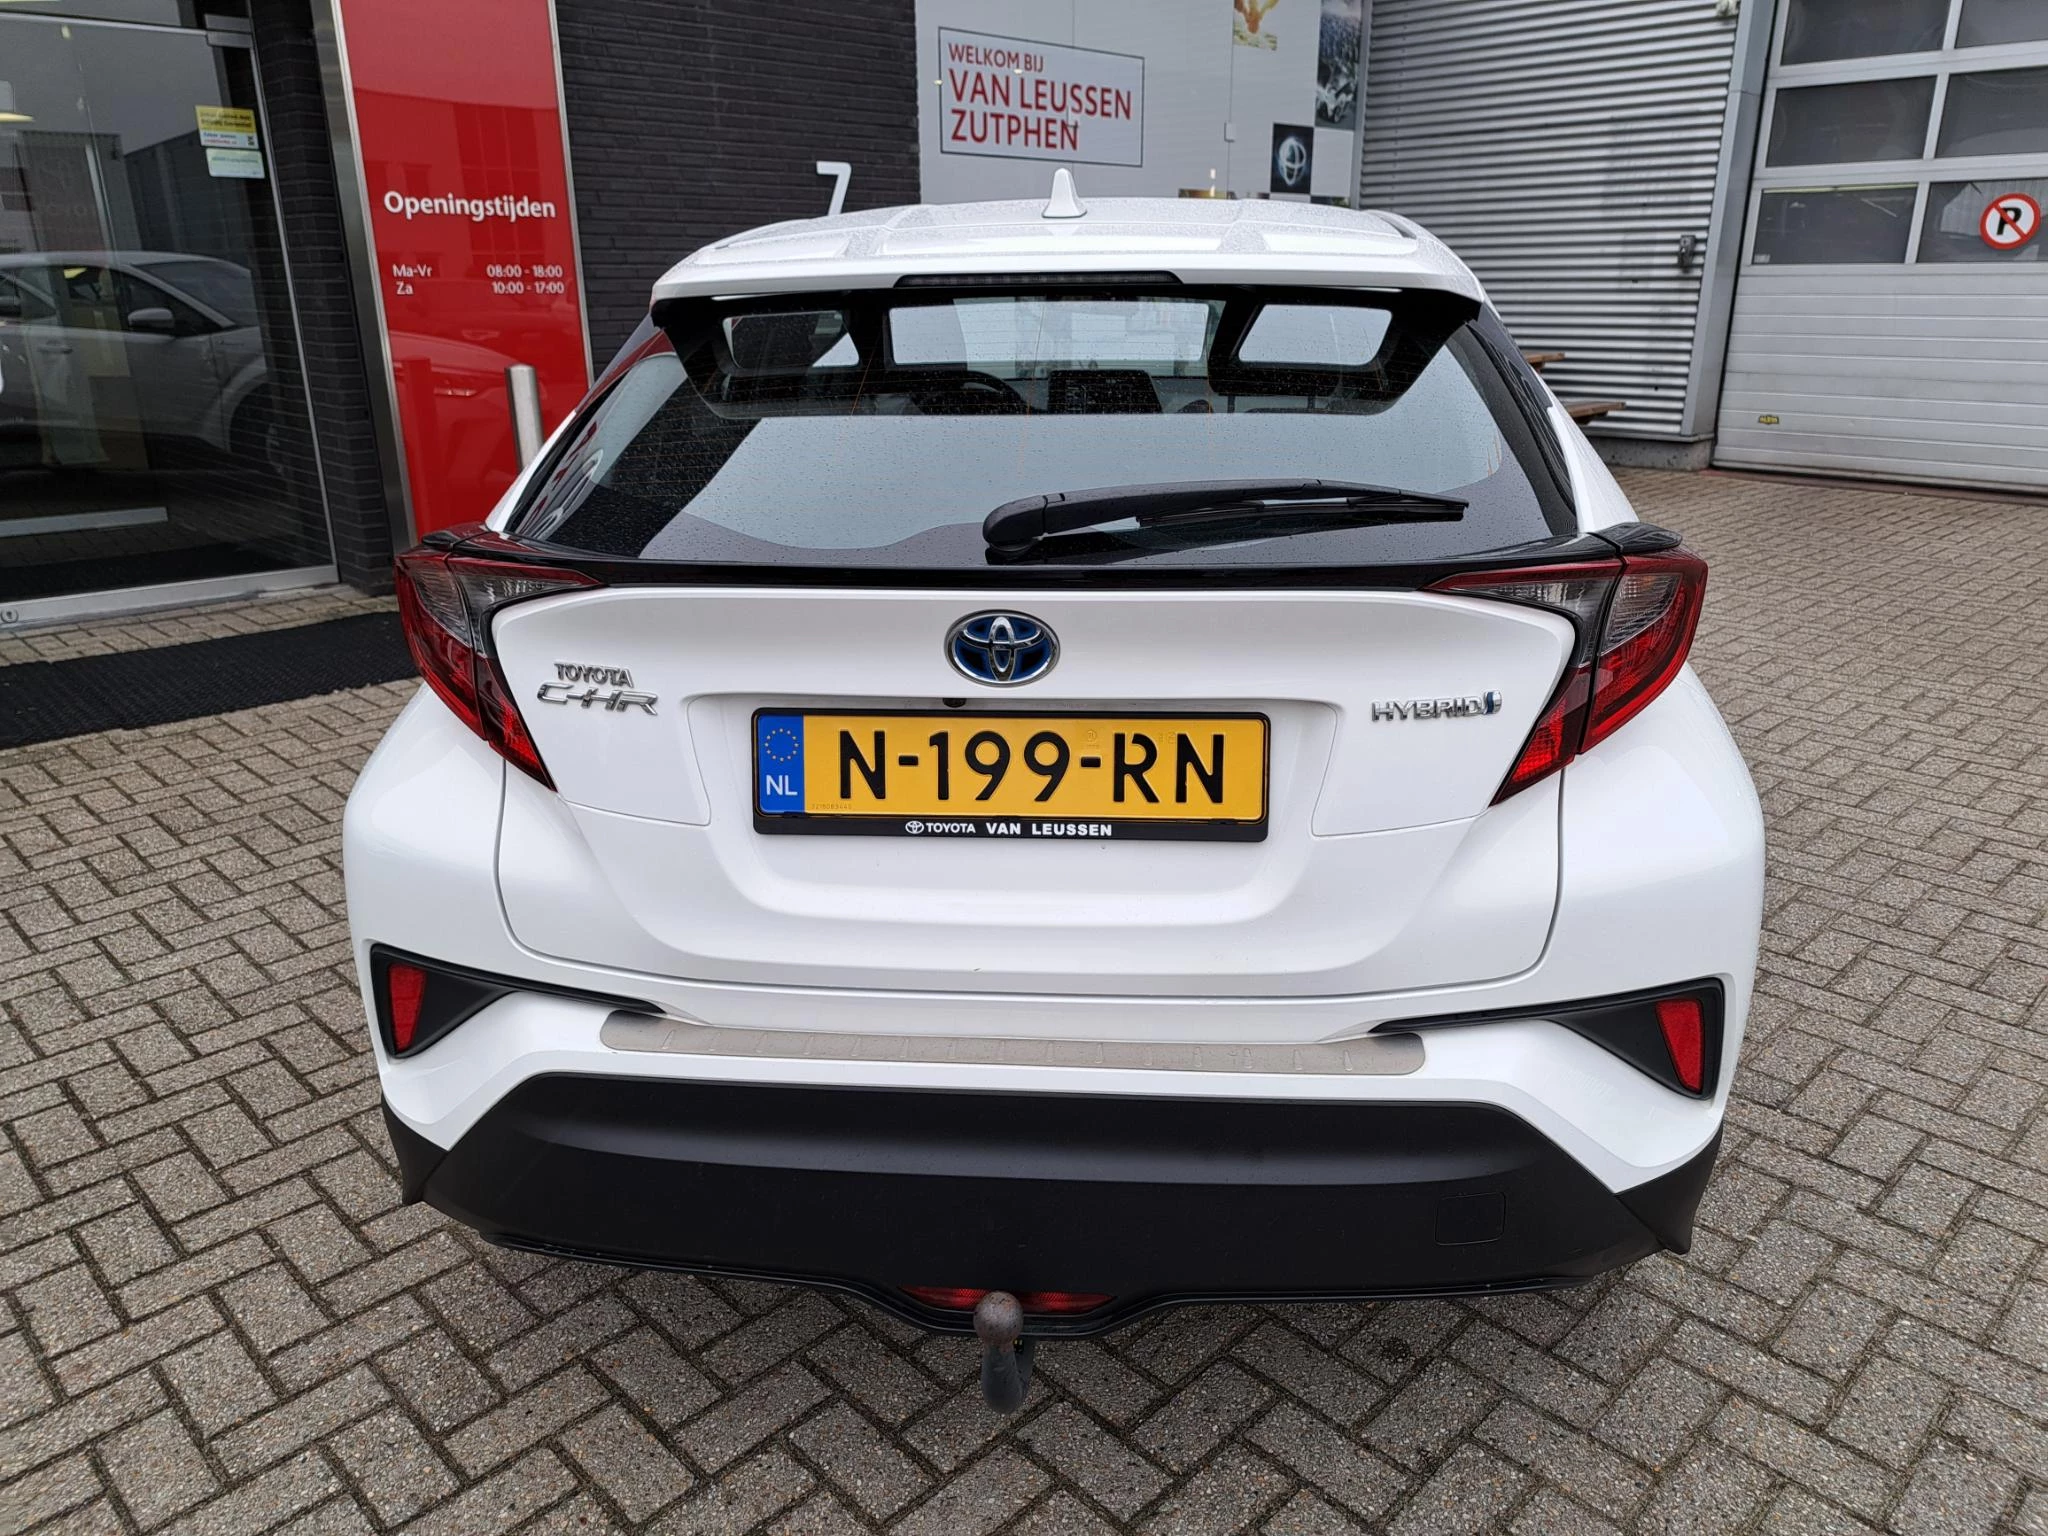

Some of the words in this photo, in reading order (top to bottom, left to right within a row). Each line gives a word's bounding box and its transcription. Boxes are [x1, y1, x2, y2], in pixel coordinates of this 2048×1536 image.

[948, 43, 1020, 69] WELKOM
[1024, 53, 1044, 73] BIJ
[949, 68, 1011, 107] VAN
[1020, 76, 1132, 120] LEUSSEN
[951, 108, 1078, 151] ZUTPHEN
[816, 160, 852, 215] 7
[383, 190, 556, 223] Openingstijden
[392, 263, 432, 278] Ma-Vr
[486, 264, 522, 278] 08:00
[533, 265, 563, 278] 18:00
[396, 281, 414, 296] Za
[492, 281, 524, 295] 10:00
[534, 281, 565, 295] 17:00
[553, 661, 634, 688] TOYOTA
[537, 681, 658, 716] C-HR
[1371, 696, 1483, 722] HYBRID
[839, 729, 1225, 804] N-199-RN
[766, 775, 798, 796] NL
[926, 822, 976, 834] TOYOTA
[985, 822, 1021, 835] VAN
[1031, 823, 1113, 837] LEUSSEN
